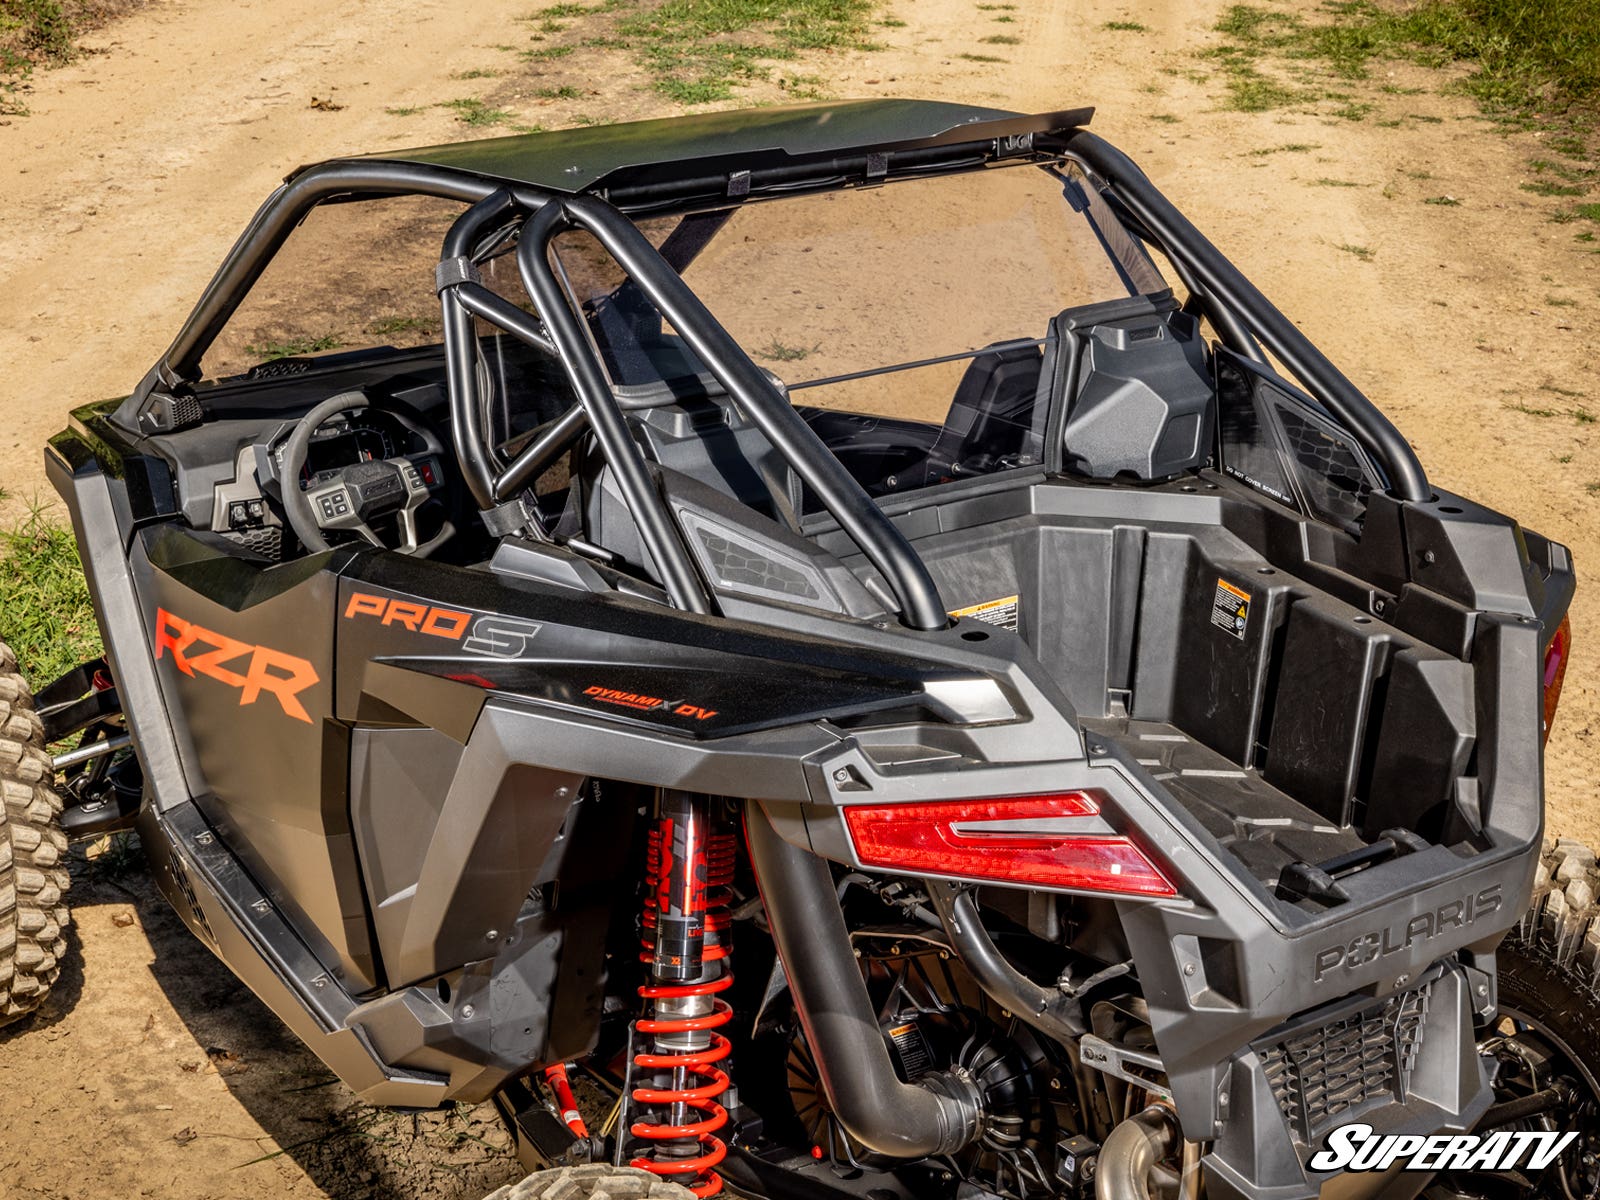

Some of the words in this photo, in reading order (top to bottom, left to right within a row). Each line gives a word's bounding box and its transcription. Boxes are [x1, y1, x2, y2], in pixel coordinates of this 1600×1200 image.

[1234, 470, 1244, 479] NOT
[1245, 475, 1262, 488] COVER
[1262, 484, 1282, 498] SCREEN
[344, 592, 473, 641] PRO
[461, 615, 543, 659] S
[155, 607, 320, 724] RZR
[673, 704, 719, 720] DV
[1313, 883, 1503, 984] POLARIS
